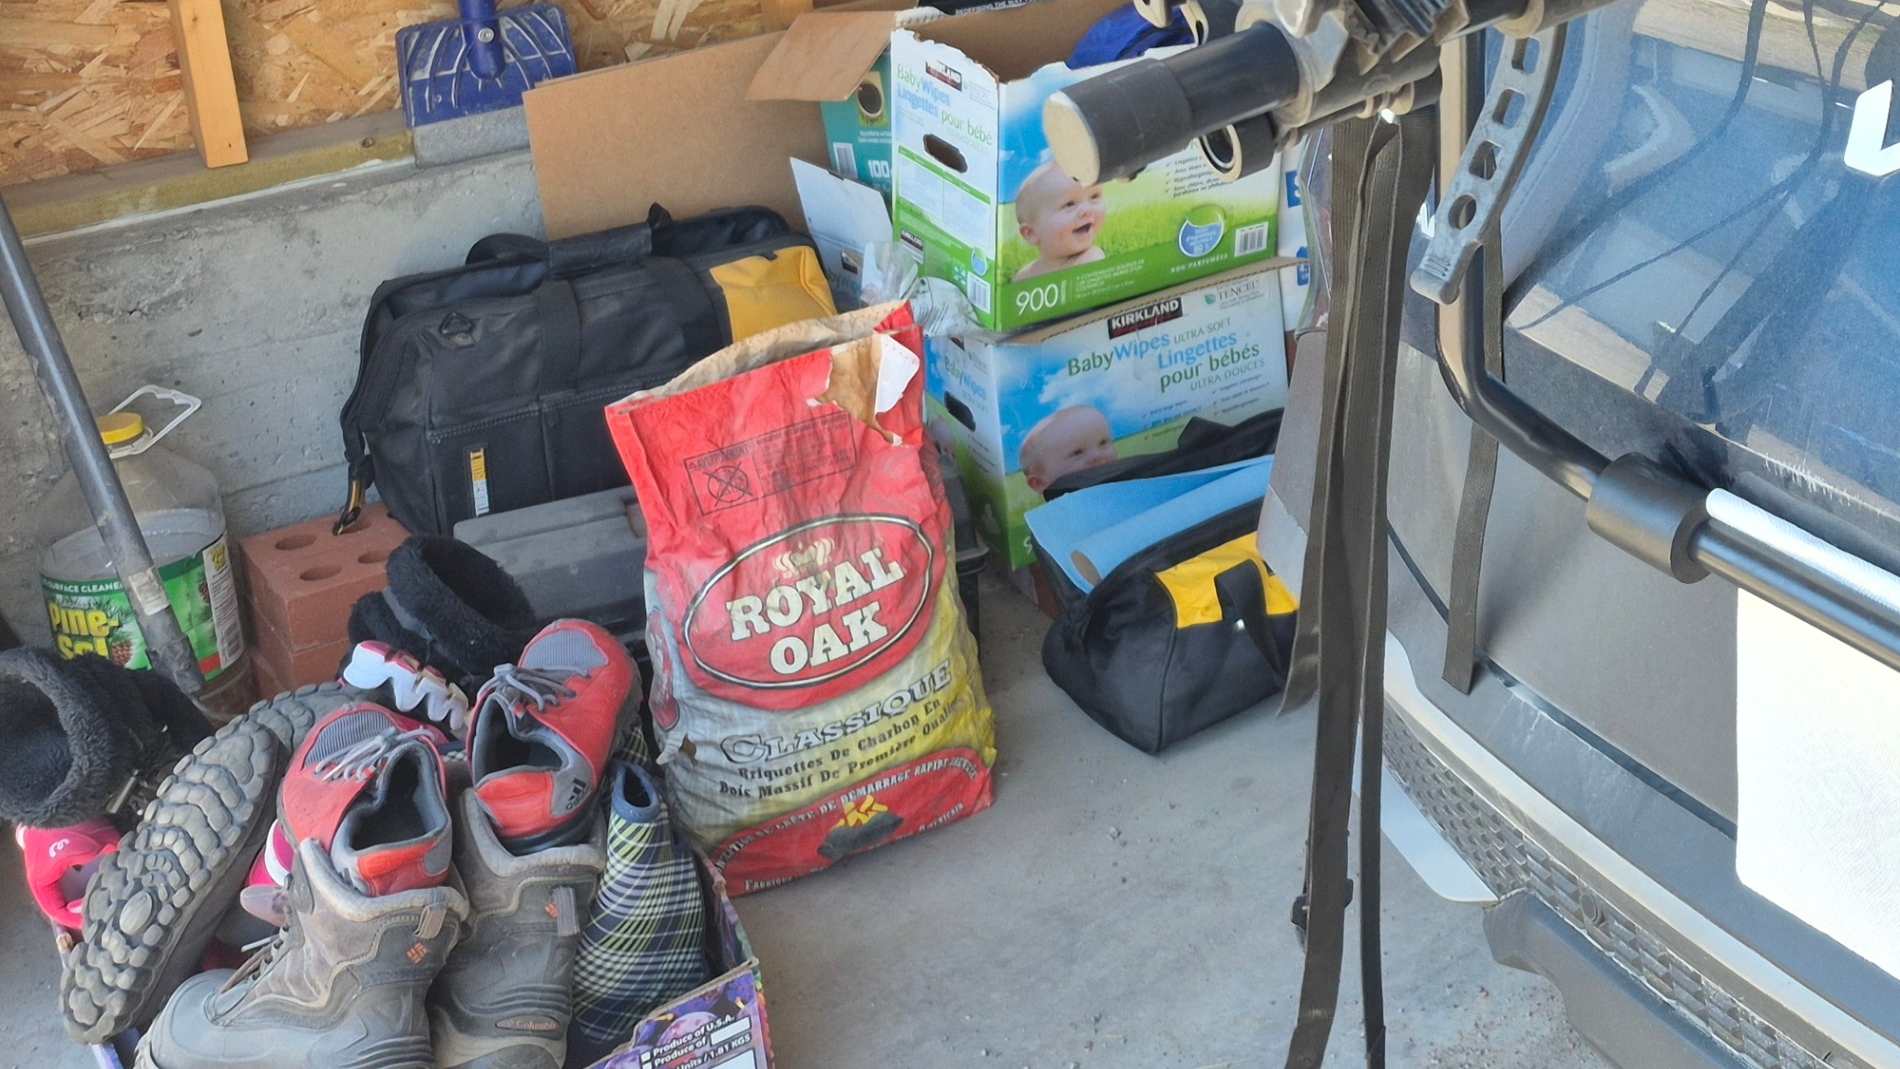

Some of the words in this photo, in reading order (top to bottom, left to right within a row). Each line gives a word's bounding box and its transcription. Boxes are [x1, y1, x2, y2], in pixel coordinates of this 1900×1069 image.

[941, 109, 963, 130] pour
[1016, 283, 1059, 316] 900
[1111, 299, 1179, 330] KIRKLAND
[1067, 333, 1170, 377] BabyWipes
[1173, 327, 1205, 345] ULTRA
[1206, 317, 1232, 334] SOFT
[1158, 332, 1238, 370] Lingettes
[1160, 363, 1203, 393] pour
[1209, 343, 1260, 372] bébés
[1190, 375, 1222, 391] ULTRA
[1224, 358, 1266, 380] DOUCES
[726, 545, 904, 642] ROYAL
[769, 602, 889, 675] OAK
[719, 660, 952, 764] CLASSIQUE
[738, 756, 823, 781] Briquettes
[830, 748, 850, 761] De
[857, 712, 920, 752] Charbon
[924, 698, 941, 714] En
[720, 781, 750, 798] Bois
[758, 776, 813, 799] Massif
[820, 769, 840, 784] De
[849, 734, 917, 775] Première
[653, 1031, 693, 1057] Produce
[694, 1024, 706, 1038] of
[706, 1014, 735, 1031] U.S.A.
[654, 1041, 694, 1067] Produce
[695, 1034, 707, 1048] of
[731, 1033, 751, 1049] KGS
